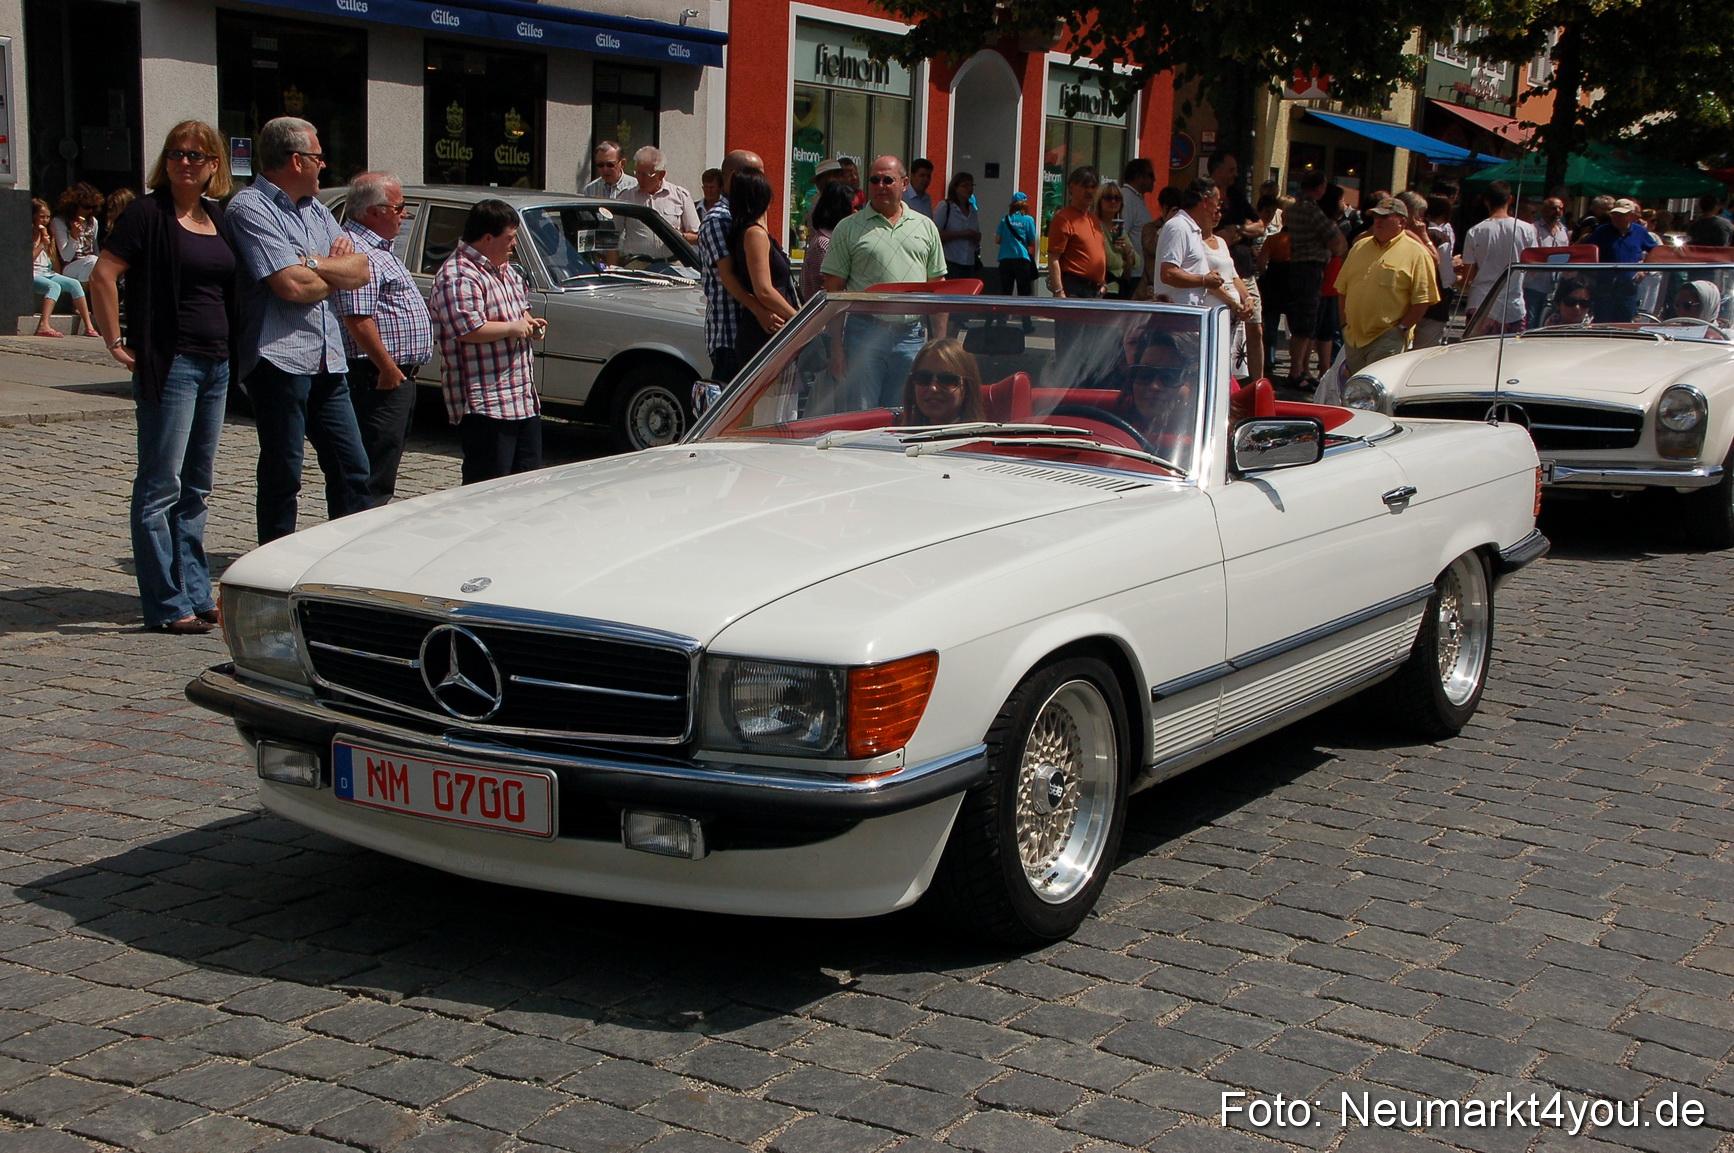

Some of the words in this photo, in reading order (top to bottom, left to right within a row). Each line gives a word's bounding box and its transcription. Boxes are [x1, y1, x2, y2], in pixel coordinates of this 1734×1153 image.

[431, 9, 460, 27] Eilles
[517, 21, 543, 39] Eilles
[595, 32, 620, 49] Eilles
[668, 43, 691, 58] Eilles
[815, 42, 890, 85] fielmann
[435, 138, 474, 161] Eilles
[494, 144, 531, 165] Eilles
[340, 777, 348, 789] D
[366, 756, 410, 805] NM
[432, 769, 526, 823] 0700
